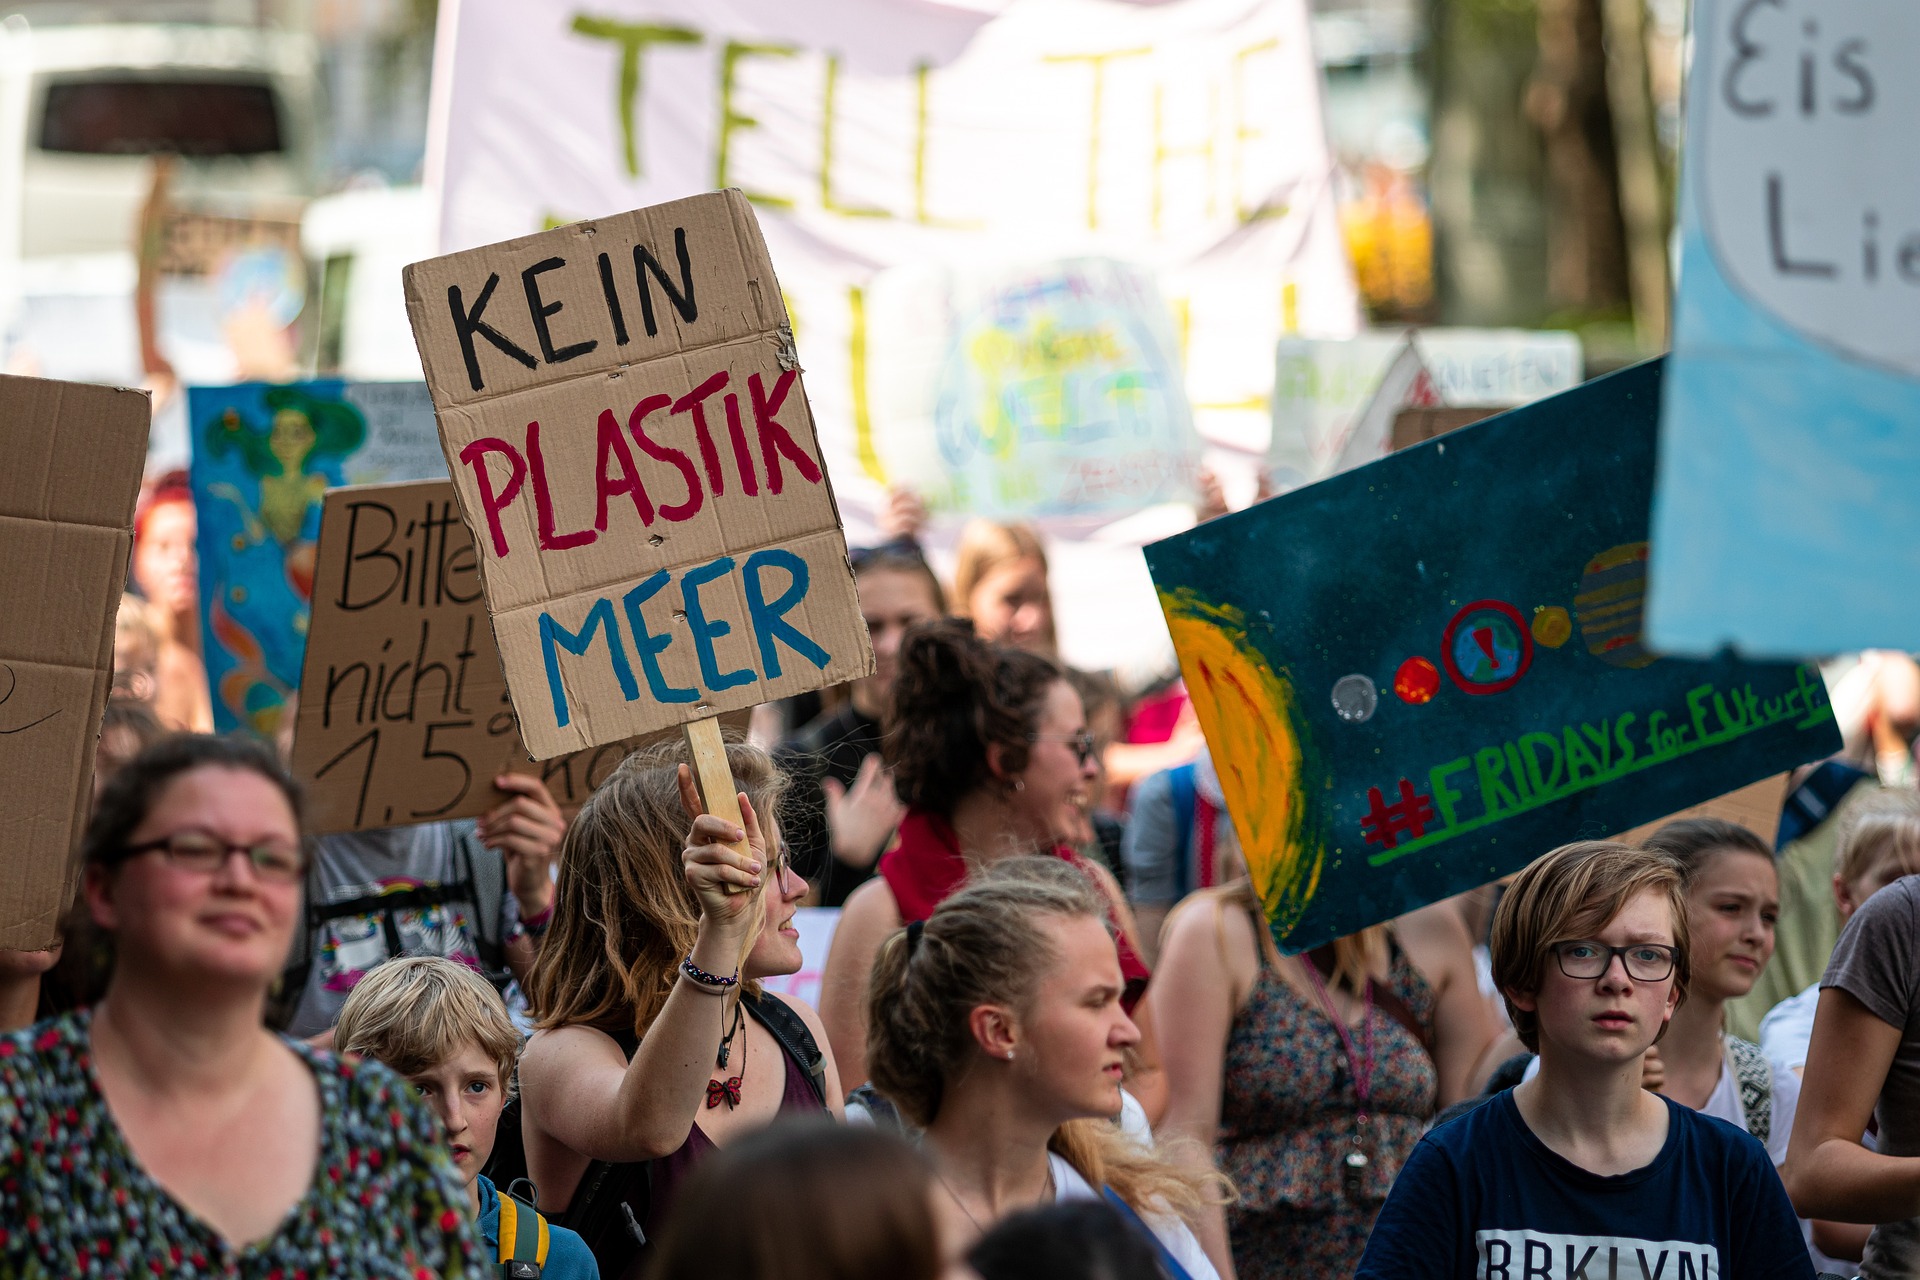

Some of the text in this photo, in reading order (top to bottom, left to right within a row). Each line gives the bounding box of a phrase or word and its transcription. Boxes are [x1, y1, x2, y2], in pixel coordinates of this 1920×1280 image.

[570, 13, 1290, 237] TELL THE
[1720, 0, 1876, 119] Eis
[447, 227, 698, 392] KEIN
[459, 370, 823, 558] PLASTIK
[335, 500, 484, 612] Bitte
[323, 614, 476, 729] nicht
[537, 549, 832, 728] MEER
[1360, 711, 1636, 849] #FRIDAYS
[1646, 709, 1690, 756] for
